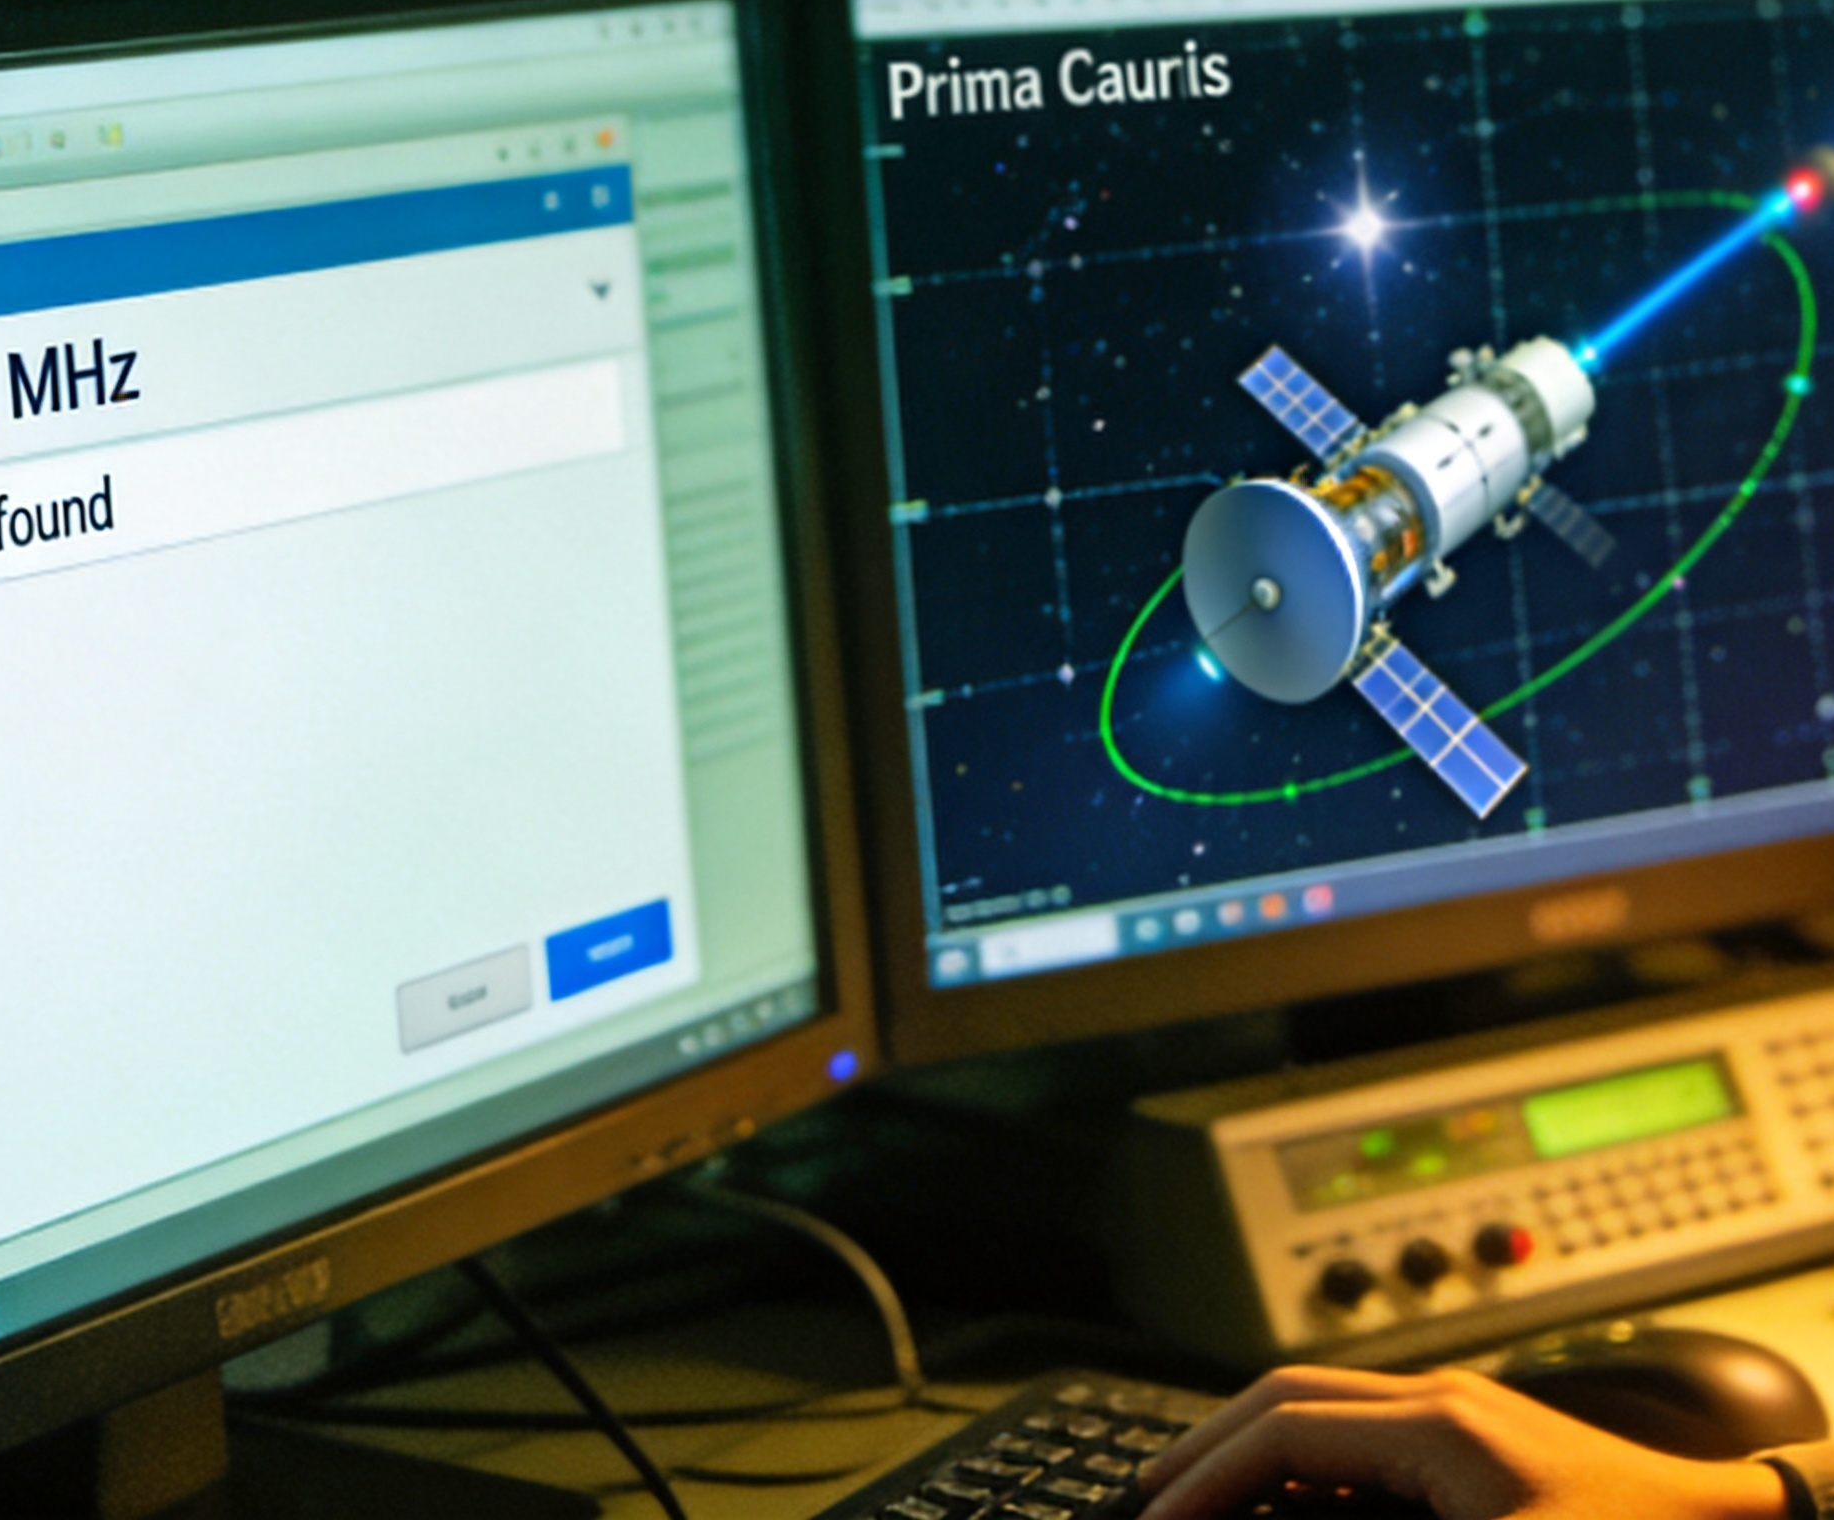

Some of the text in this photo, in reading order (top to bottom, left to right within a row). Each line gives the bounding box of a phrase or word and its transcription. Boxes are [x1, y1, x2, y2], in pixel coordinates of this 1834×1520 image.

[887, 39, 1233, 121] Prima Cauris
[7, 337, 142, 421] MHz
